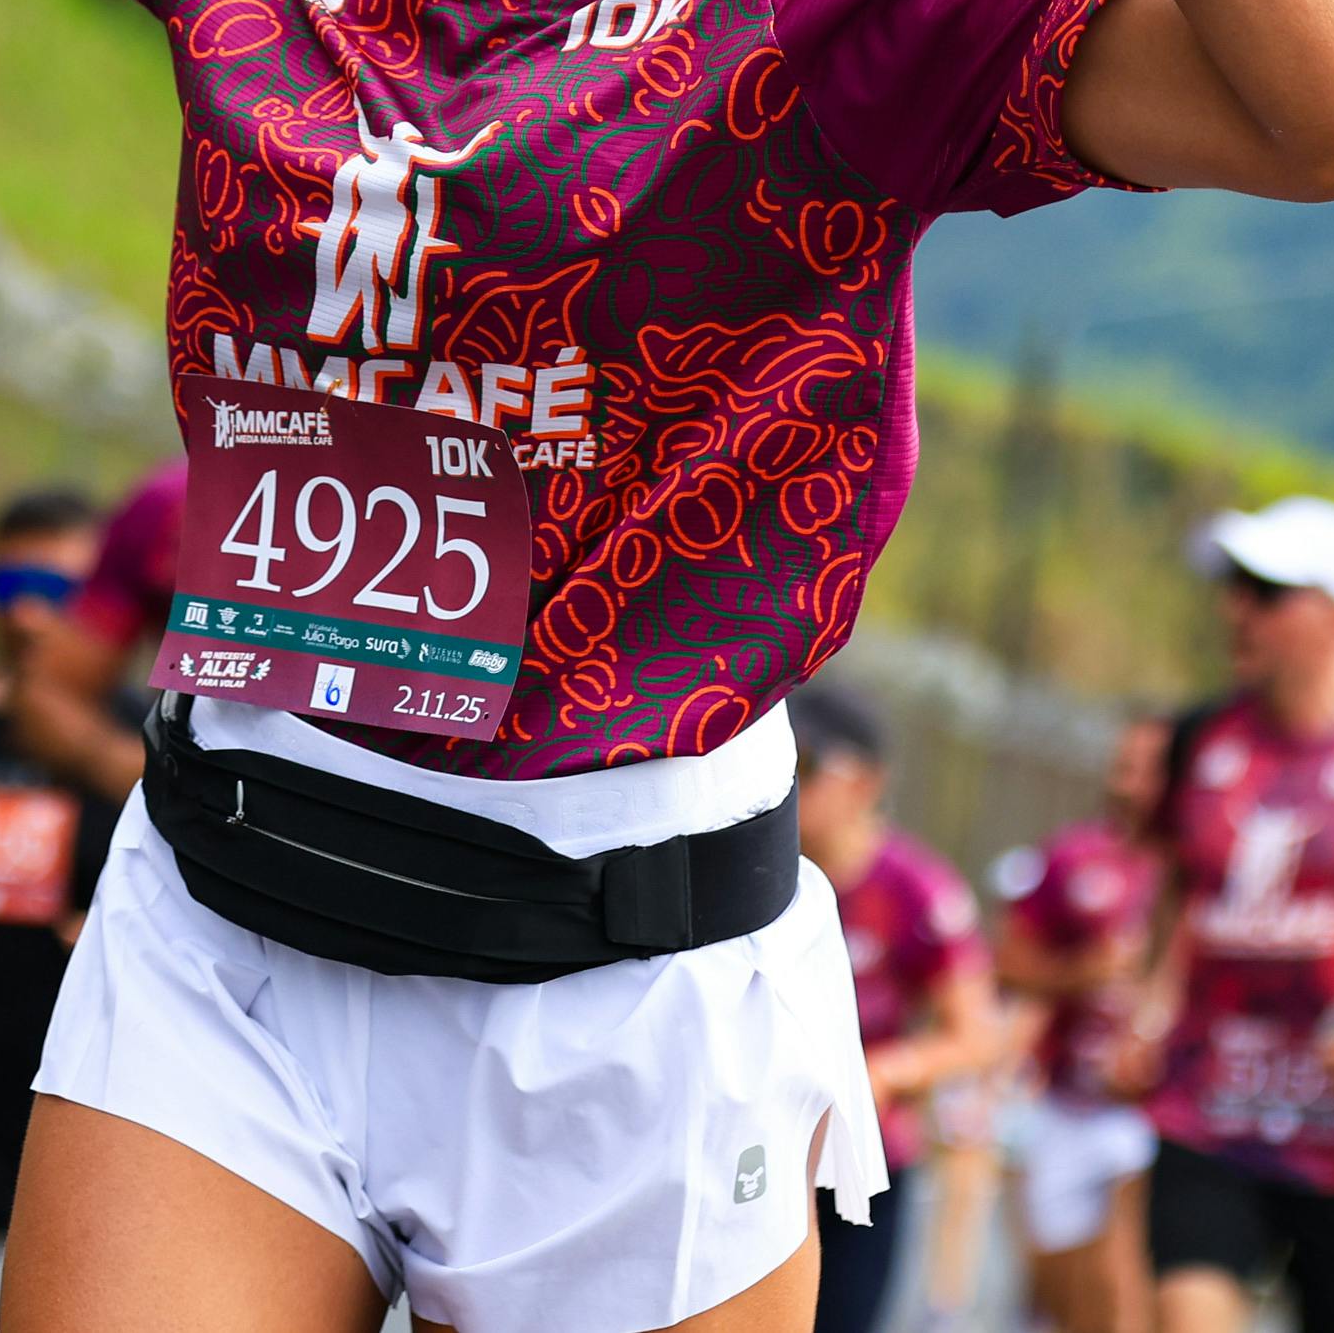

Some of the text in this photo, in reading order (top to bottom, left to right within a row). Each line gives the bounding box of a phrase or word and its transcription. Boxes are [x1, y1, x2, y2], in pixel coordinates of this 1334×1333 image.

[235, 434, 333, 446] MEDIA MARATÓN DEL CAFÉ
[513, 434, 597, 468] CAFÉ
[425, 435, 494, 478] 10K
[219, 468, 491, 620] 4925
[301, 628, 325, 643] Julio
[365, 636, 399, 654] sura
[198, 660, 251, 678] ALAS
[468, 649, 508, 673] Frisby
[195, 678, 247, 688] PARA VOLAR
[325, 668, 340, 706] 6
[393, 684, 487, 723] 2.11.25
